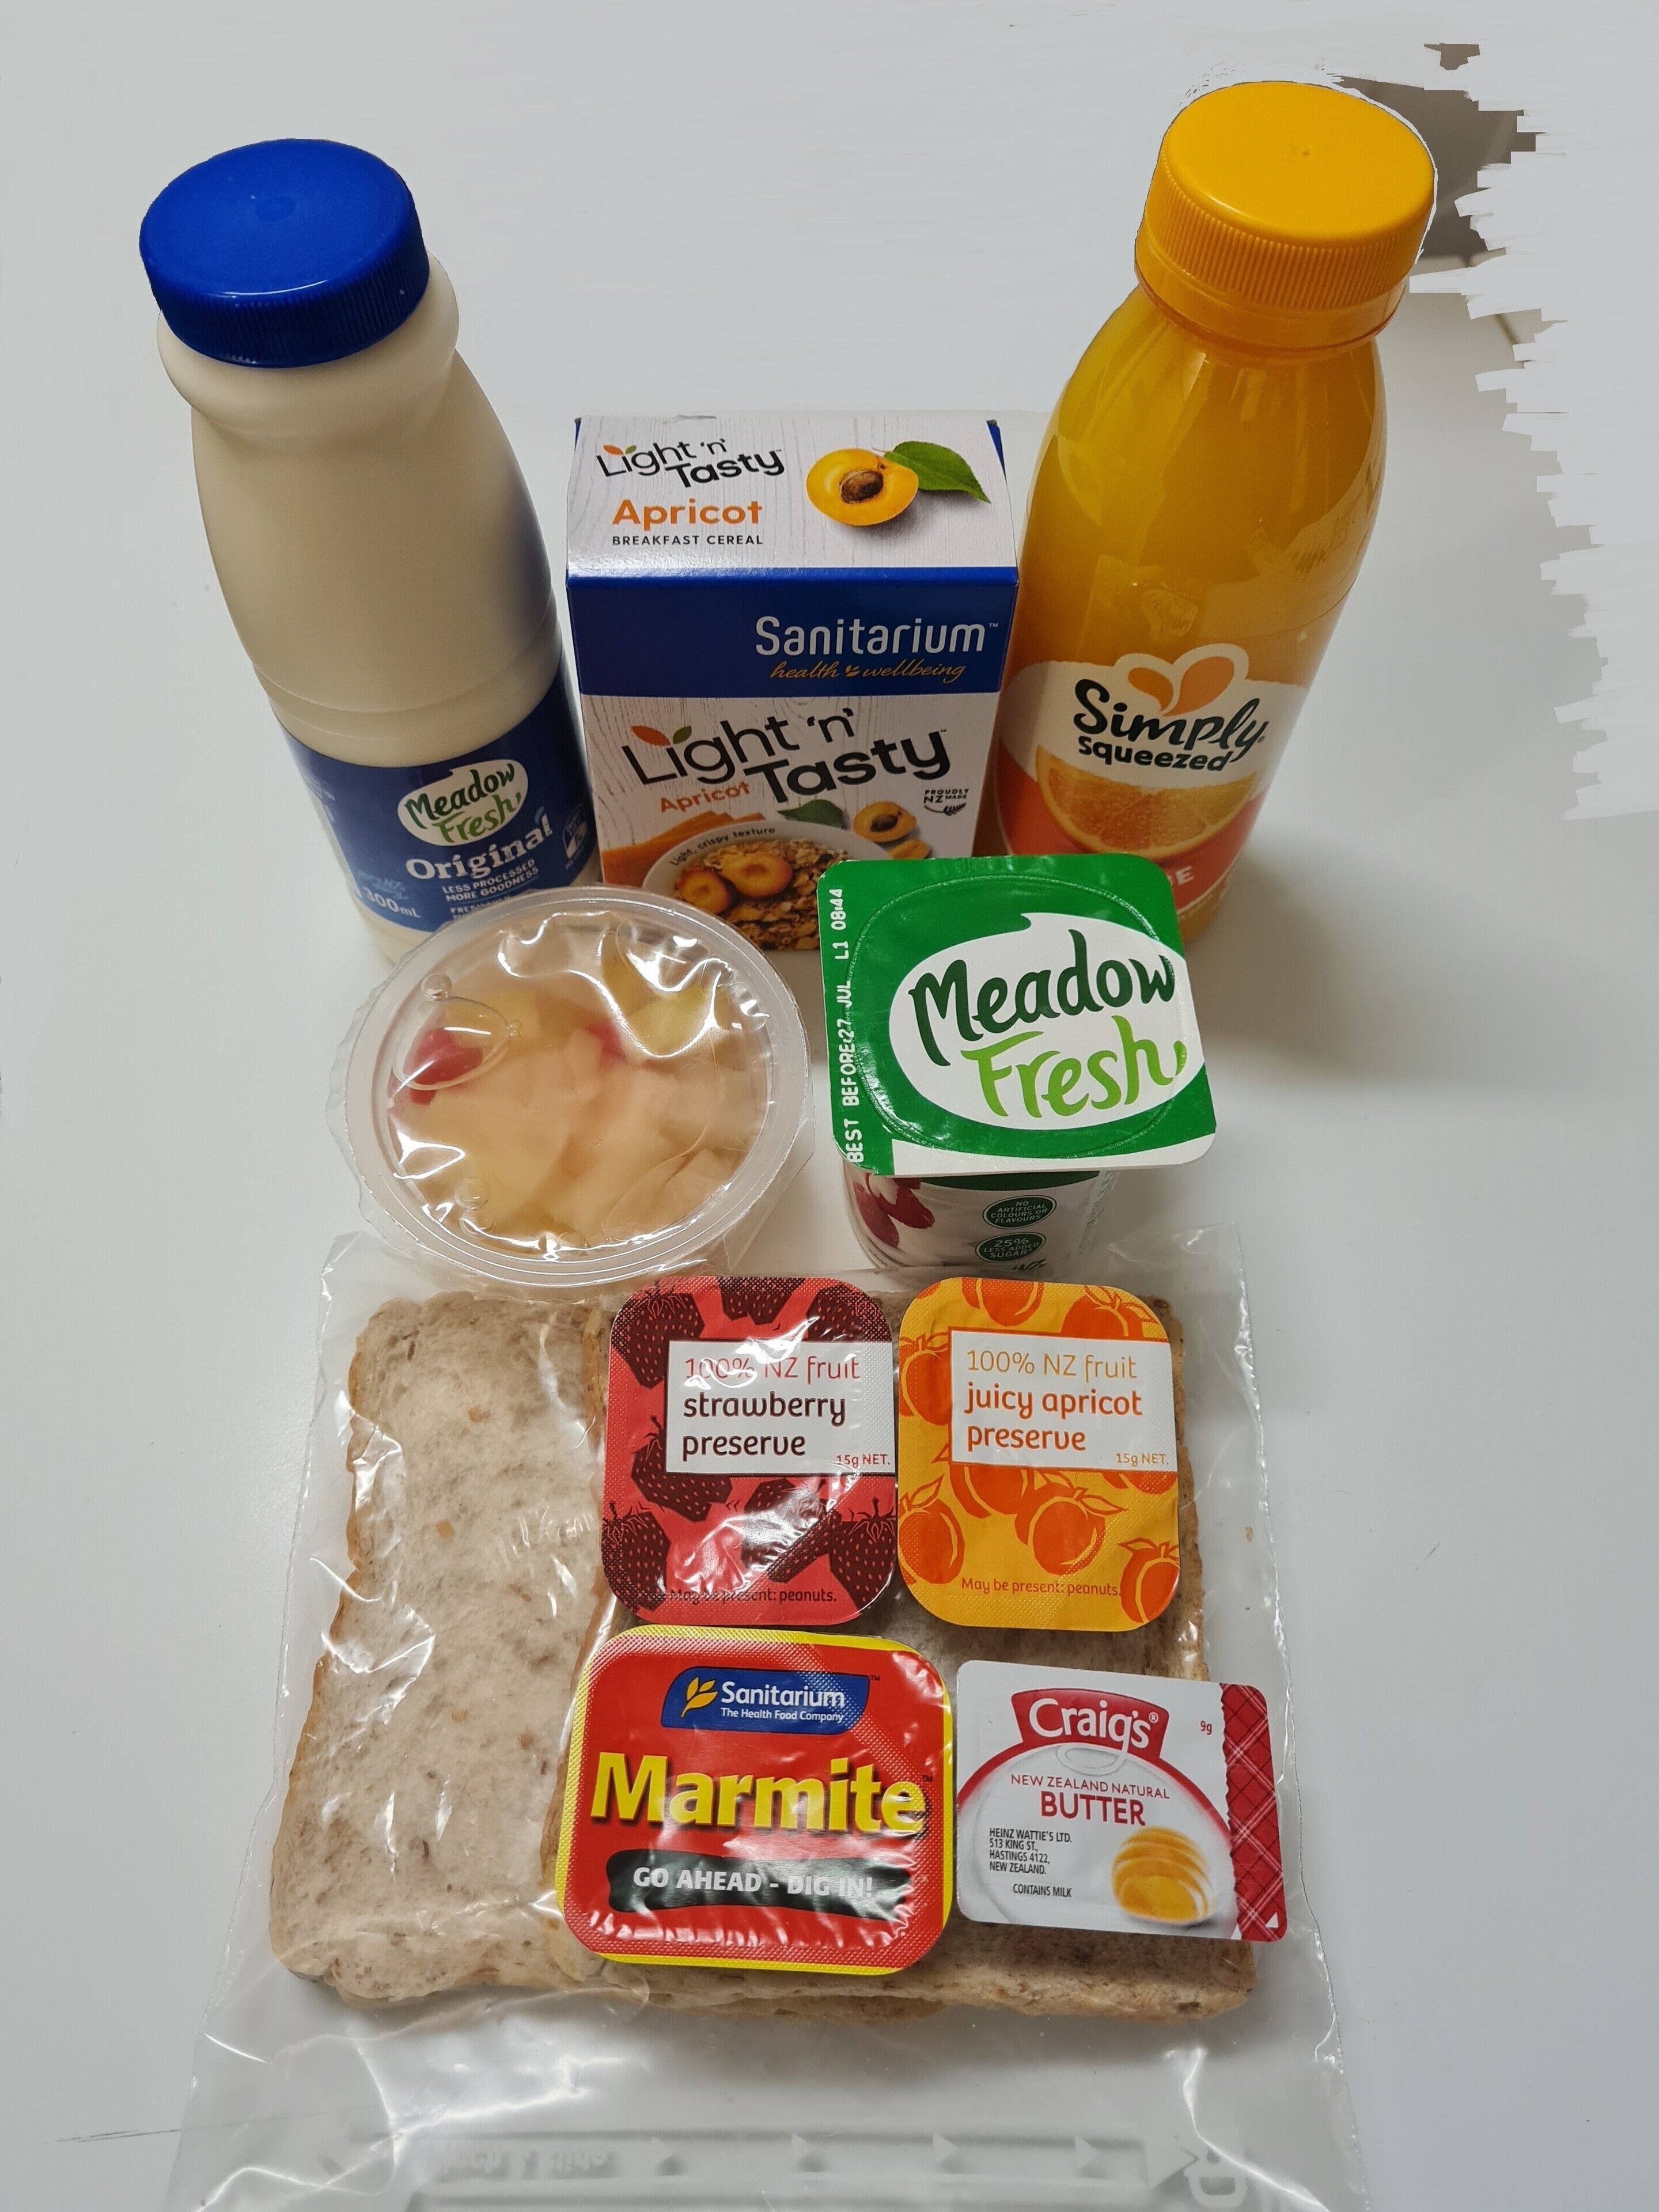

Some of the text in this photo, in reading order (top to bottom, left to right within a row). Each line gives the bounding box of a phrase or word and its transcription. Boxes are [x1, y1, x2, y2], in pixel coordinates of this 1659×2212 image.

[596, 442, 692, 478] Light
[666, 449, 785, 488] Tasty
[612, 499, 763, 531] Apricot
[612, 535, 763, 545] BREAKFAST CEREAL
[755, 616, 985, 656] Sanitarium
[770, 660, 966, 683] health wellbeing
[1073, 679, 1269, 763] Simply
[623, 715, 800, 785] Light
[1078, 736, 1234, 771] squeezed
[744, 731, 950, 803] Tasty
[404, 763, 516, 829] Meadow
[660, 781, 750, 812] Apricot
[432, 792, 521, 843] Fresh
[406, 813, 553, 880] Original
[698, 835, 729, 850] crispy
[733, 828, 775, 838] texture
[442, 859, 535, 893] LESS PROCESSED
[446, 867, 539, 902] MORE GOODNESS
[829, 888, 847, 929] 08:44
[833, 941, 849, 959] L1
[836, 980, 853, 1007] JUL
[908, 929, 1176, 1066] Meadow
[961, 1015, 1186, 1118] Fresh
[844, 1119, 864, 1162] BEST
[997, 1204, 1046, 1213] ARTIFICIAL
[994, 1238, 1029, 1247] 25%
[685, 1356, 861, 1384] 100% NZ fruit
[966, 1350, 1137, 1382] 100% NZ fruit
[683, 1392, 846, 1426] strawberry
[964, 1382, 1143, 1419] juicy apricot
[681, 1434, 806, 1461] preserve
[967, 1425, 1086, 1452] preserve
[836, 1454, 891, 1467] 15g NET.
[1116, 1453, 1169, 1467] 15g NET.
[779, 1588, 837, 1604] peanuts.
[961, 1578, 990, 1594] May
[994, 1578, 1009, 1592] be
[1012, 1581, 1064, 1595] present:
[721, 1681, 846, 1707] Sanitarium
[721, 1708, 844, 1723] The Health Food Company
[1200, 1720, 1212, 1735] 9g
[590, 1751, 927, 1835] Marmite
[1010, 1773, 1170, 1800] NEW ZEALAND NATURAL
[1040, 1791, 1146, 1826] BUTTER
[990, 1827, 1071, 1842] HEINZ WATTIE'S LTD.
[990, 1838, 1002, 1848] 513
[1005, 1839, 1024, 1850] KING
[990, 1850, 1050, 1865] HASTINGS 4122,
[990, 1861, 1046, 1874] NEW ZEALAND.
[634, 1866, 669, 1888] GO
[675, 1869, 761, 1893] AHEAD
[787, 1873, 831, 1896] DIG
[838, 1876, 873, 1899] IN!
[1013, 1884, 1071, 1897] CONTAINS MILK
